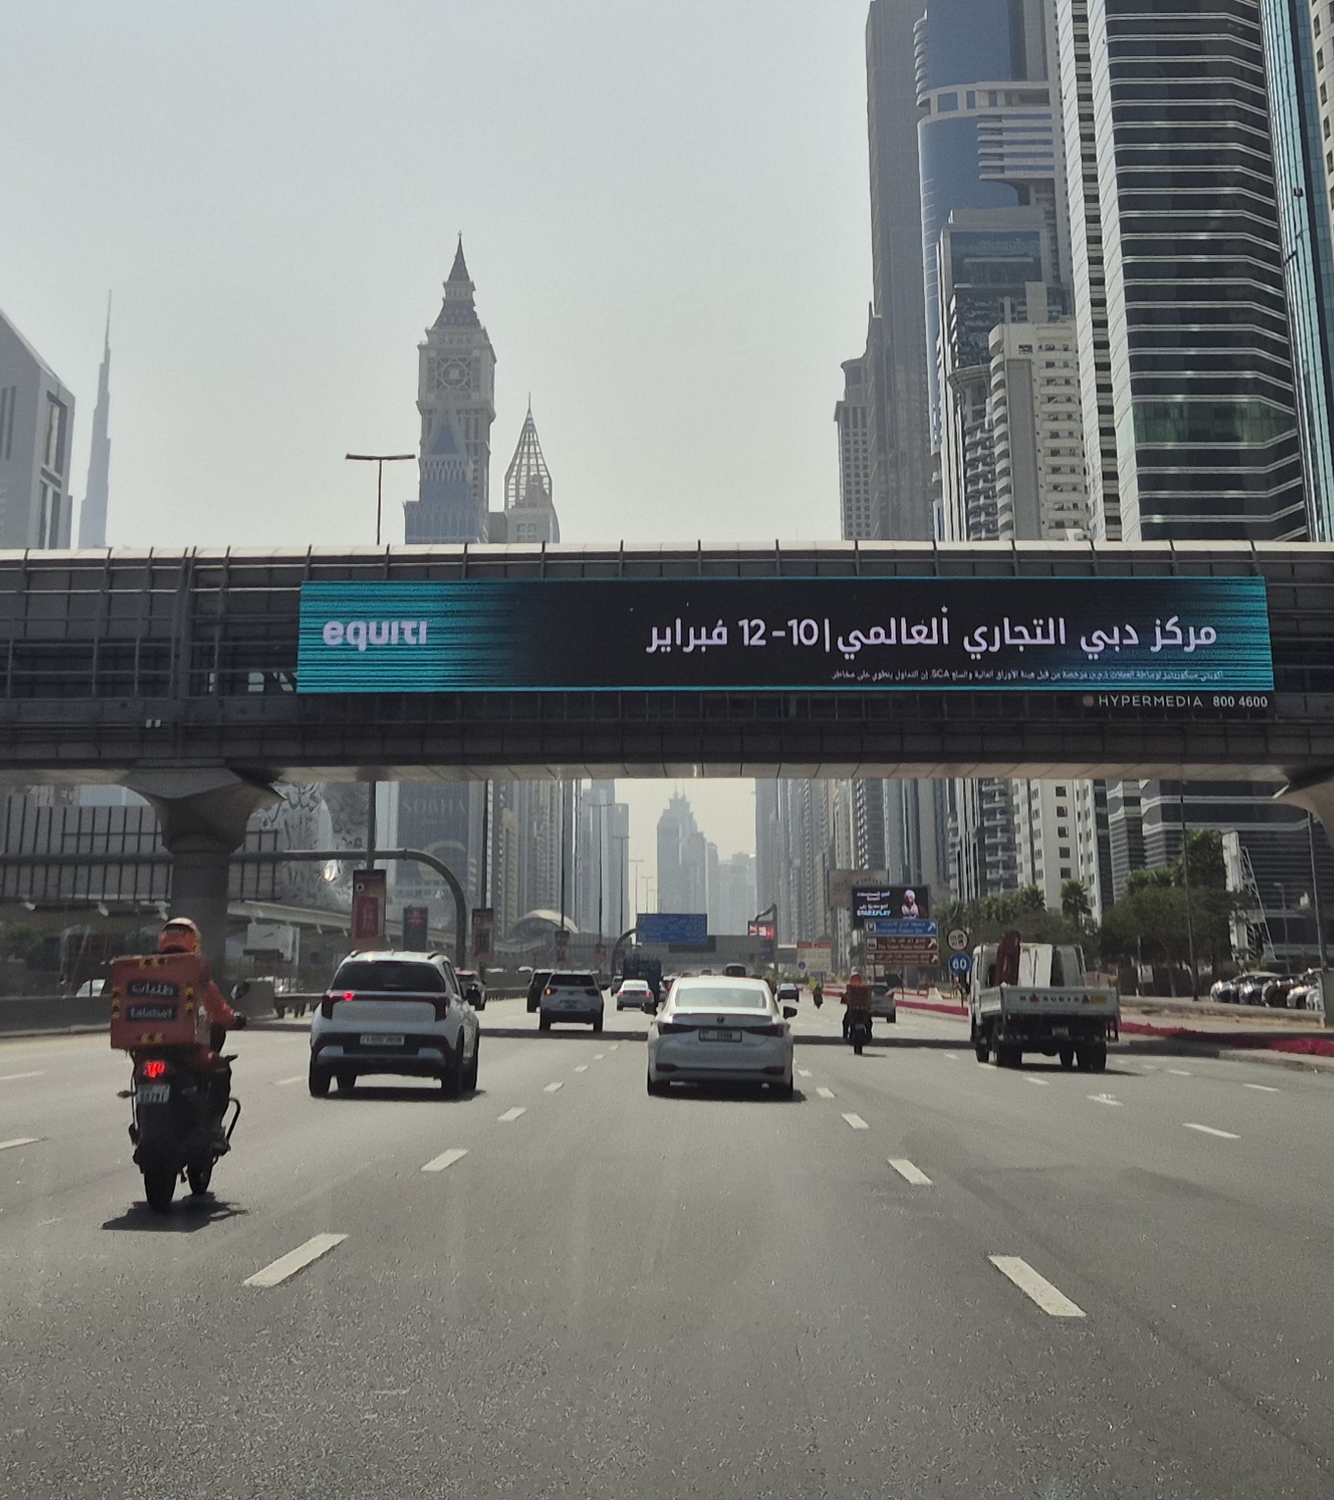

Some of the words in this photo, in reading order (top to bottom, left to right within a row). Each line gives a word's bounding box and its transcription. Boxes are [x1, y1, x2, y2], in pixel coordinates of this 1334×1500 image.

[323, 620, 428, 651] equiti
[646, 617, 728, 653] فبراير
[963, 617, 1066, 660] التجاري
[1080, 623, 1139, 660] دبي
[1151, 615, 1217, 652] مركز
[1098, 695, 1203, 708] HYPERMEDIA
[1212, 696, 1235, 708] 800
[1238, 696, 1268, 708] 4600
[952, 958, 967, 970] 60
